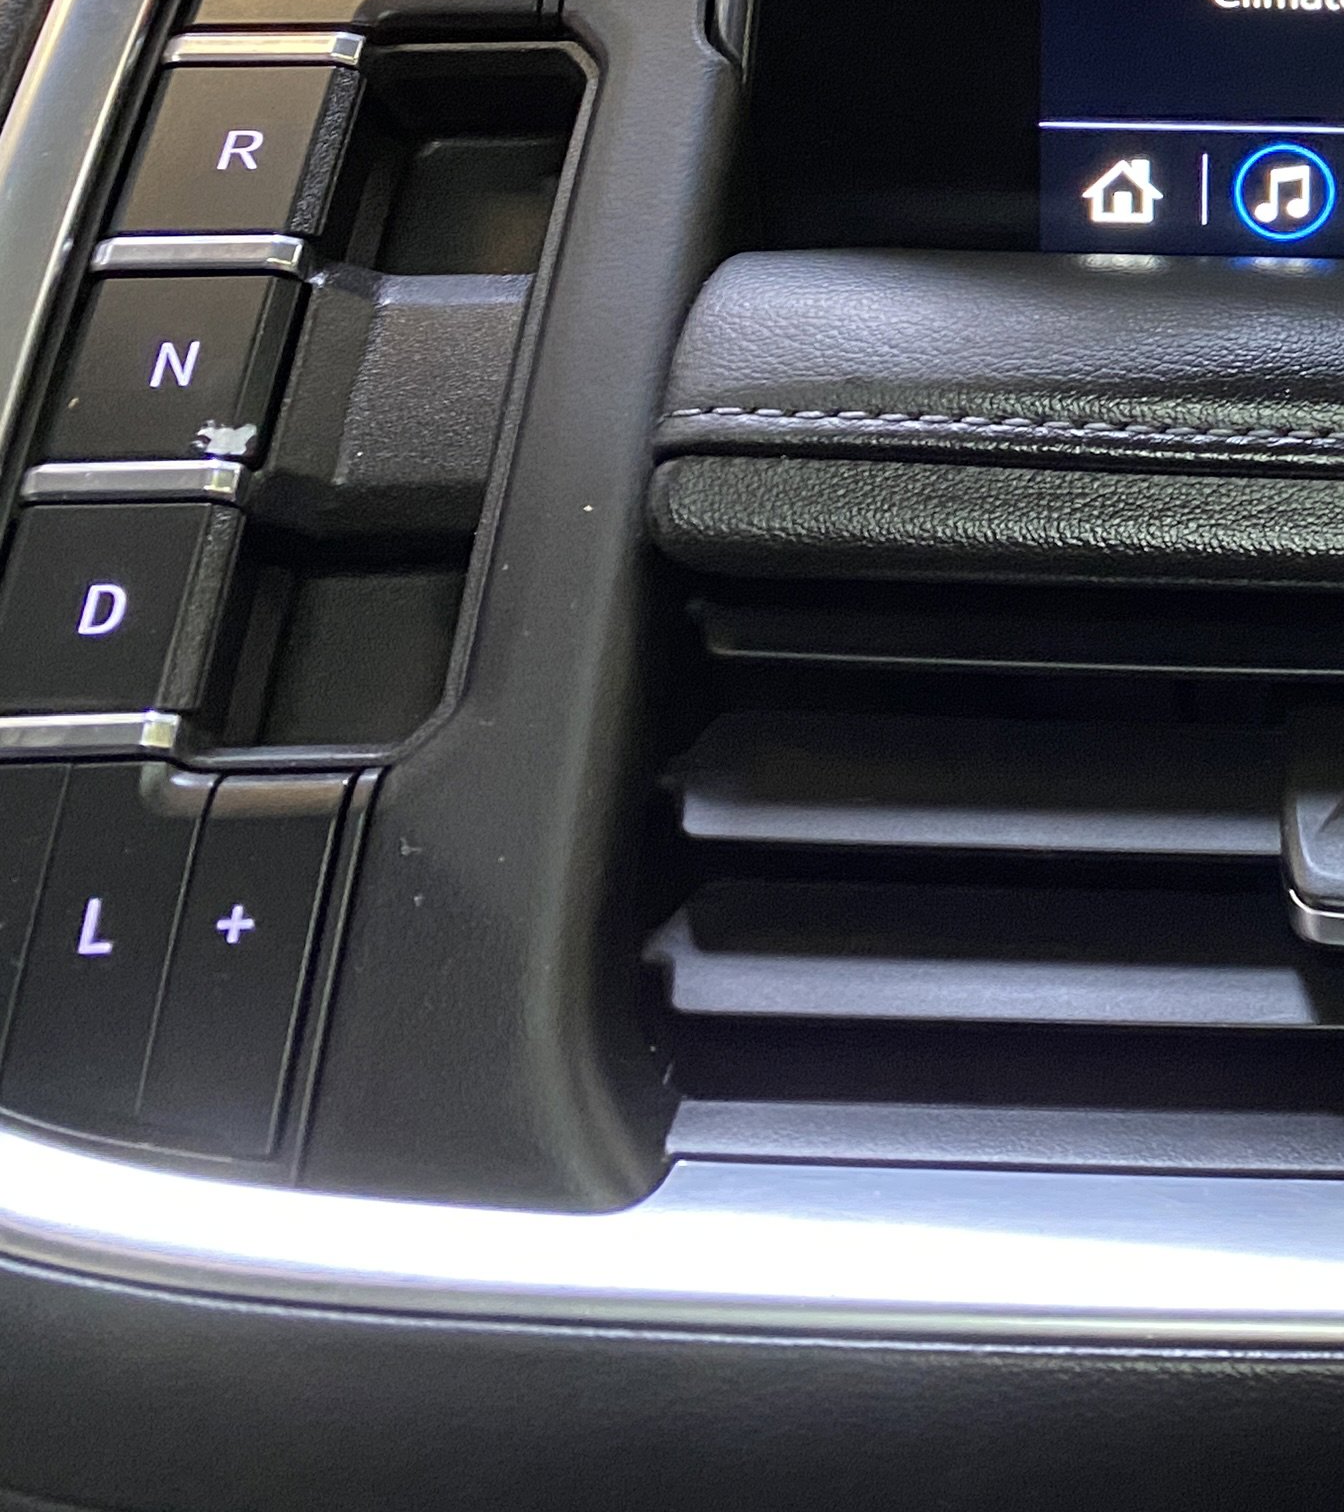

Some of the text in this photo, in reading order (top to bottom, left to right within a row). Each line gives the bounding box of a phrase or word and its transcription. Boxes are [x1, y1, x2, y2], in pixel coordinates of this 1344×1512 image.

[215, 129, 265, 171] R
[148, 339, 202, 389] N
[76, 582, 128, 637] D
[76, 896, 114, 956] L
